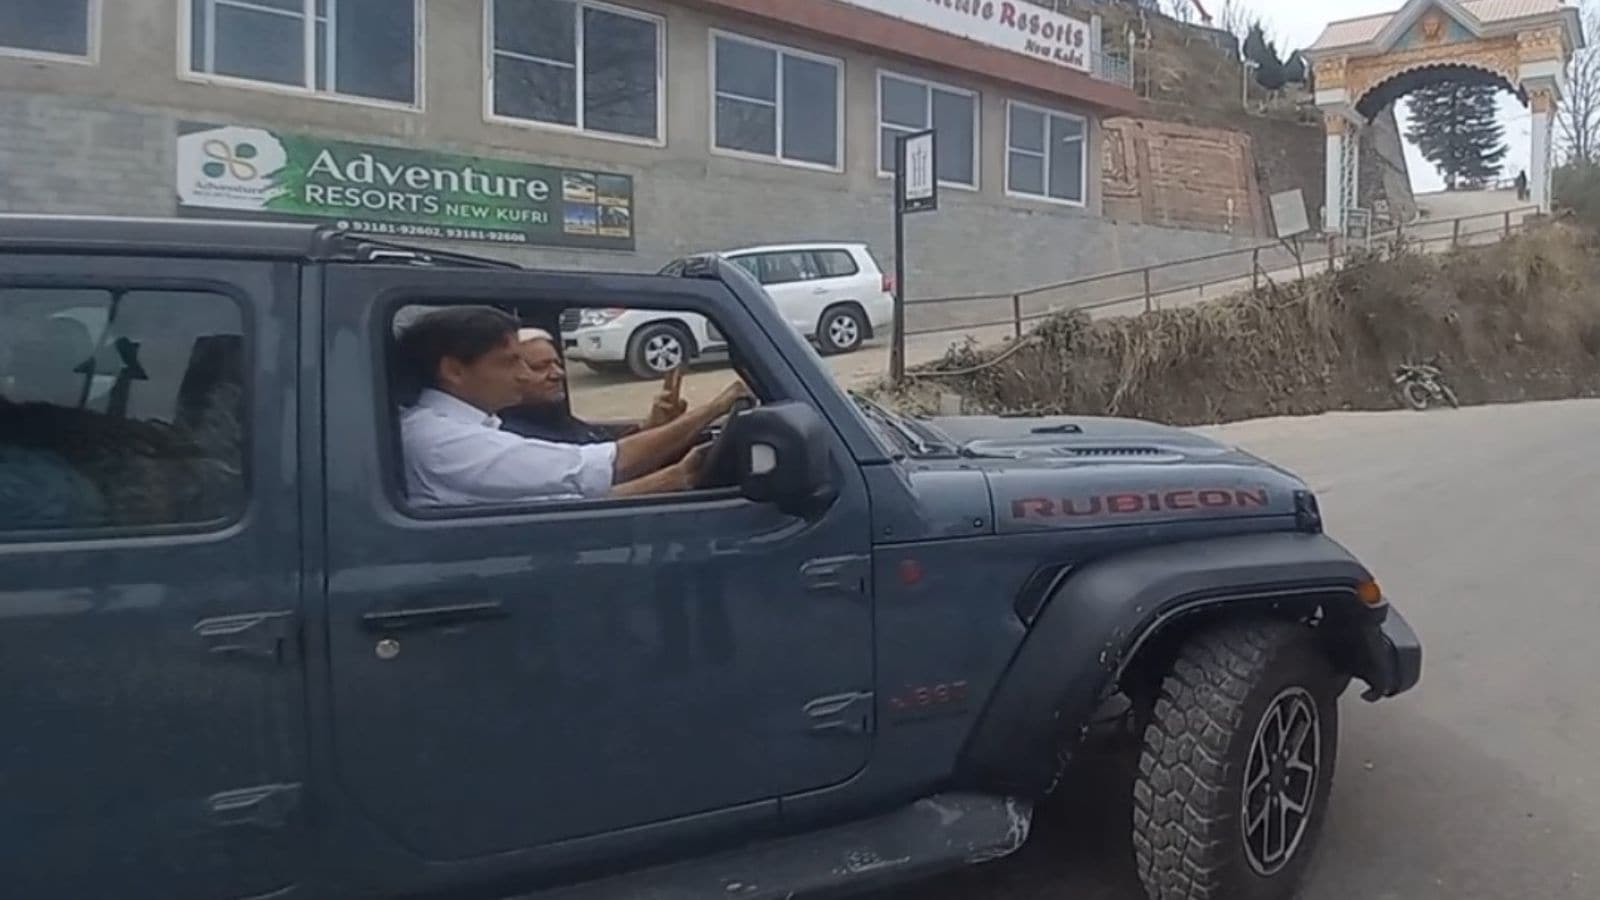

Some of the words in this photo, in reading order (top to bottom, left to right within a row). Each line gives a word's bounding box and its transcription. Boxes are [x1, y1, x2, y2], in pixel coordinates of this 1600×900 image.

[1000, 2, 1084, 48] Resorts
[306, 149, 549, 200] Adventure
[305, 184, 439, 214] RESORTS
[446, 204, 490, 219] NEW
[497, 209, 549, 224] KUFRI
[1011, 488, 1269, 519] RUBICON
